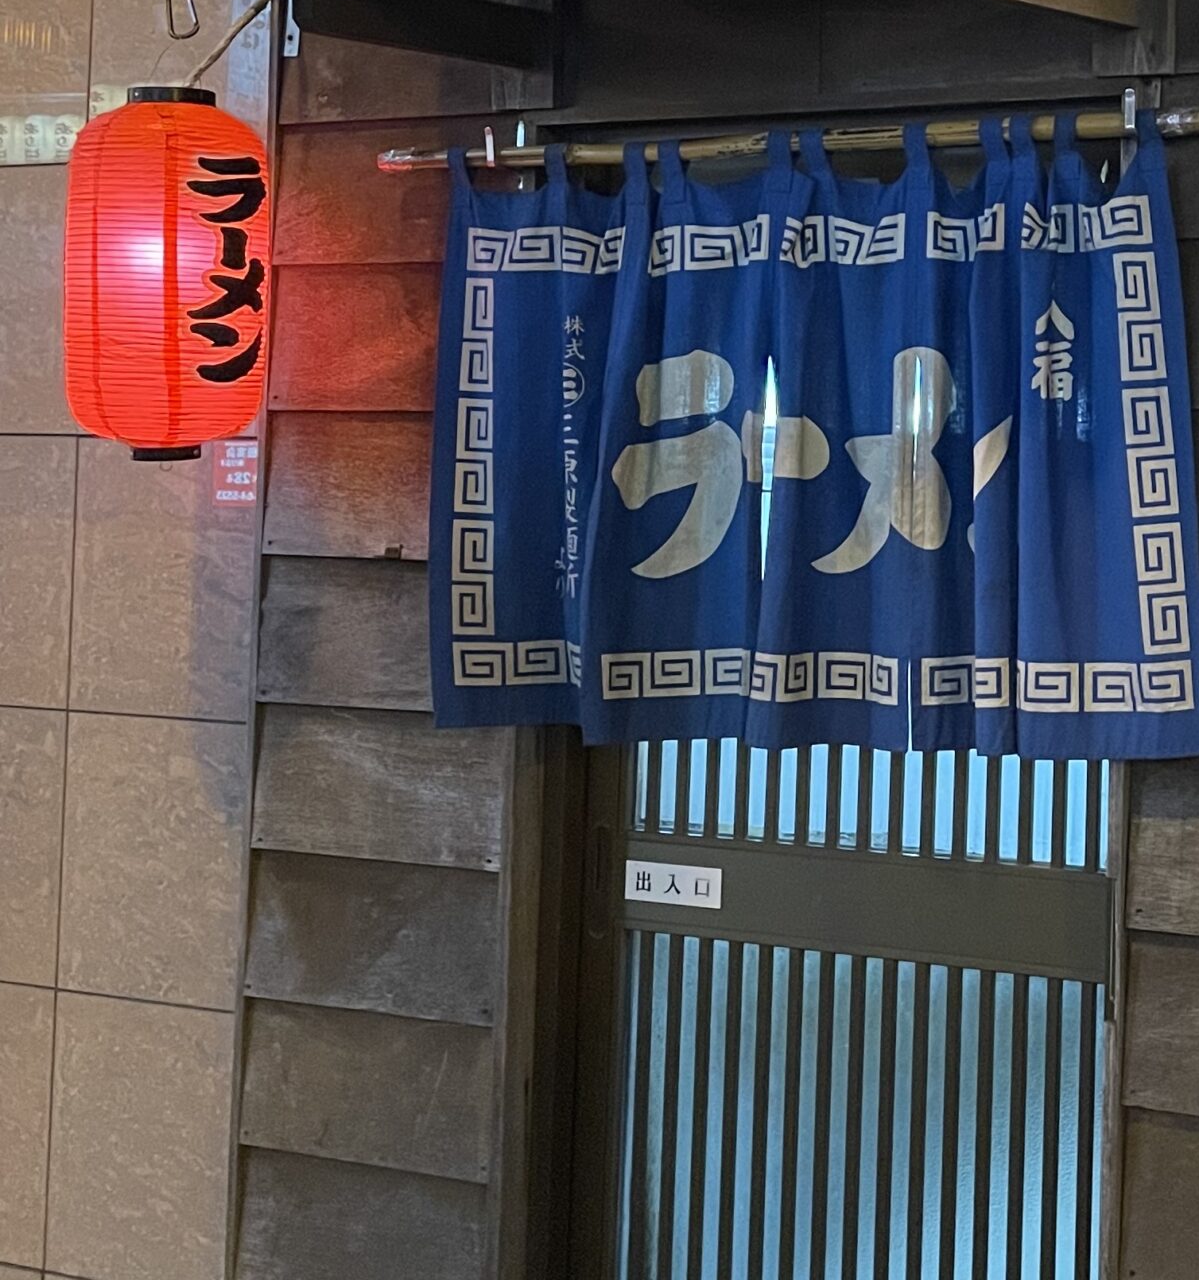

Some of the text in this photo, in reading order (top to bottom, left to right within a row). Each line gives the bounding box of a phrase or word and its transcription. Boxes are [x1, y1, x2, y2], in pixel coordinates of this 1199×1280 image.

[186, 156, 266, 382] ラーメン
[636, 871, 710, 898] 出入口
